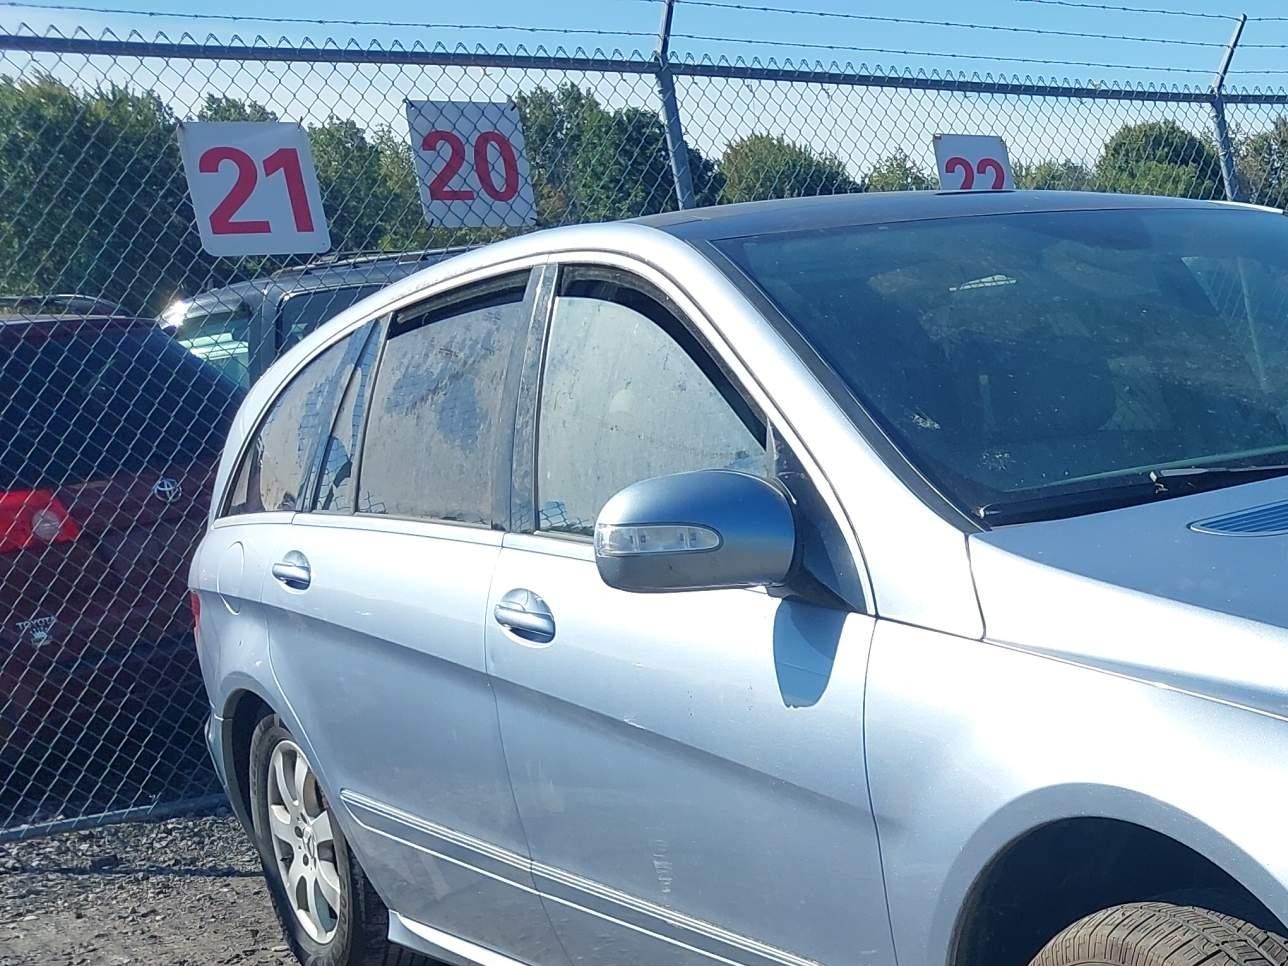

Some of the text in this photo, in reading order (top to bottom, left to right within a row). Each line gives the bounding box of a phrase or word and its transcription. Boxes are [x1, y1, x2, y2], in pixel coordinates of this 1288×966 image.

[200, 148, 314, 234] 21
[422, 131, 518, 201] 20
[944, 156, 1005, 190] 22
